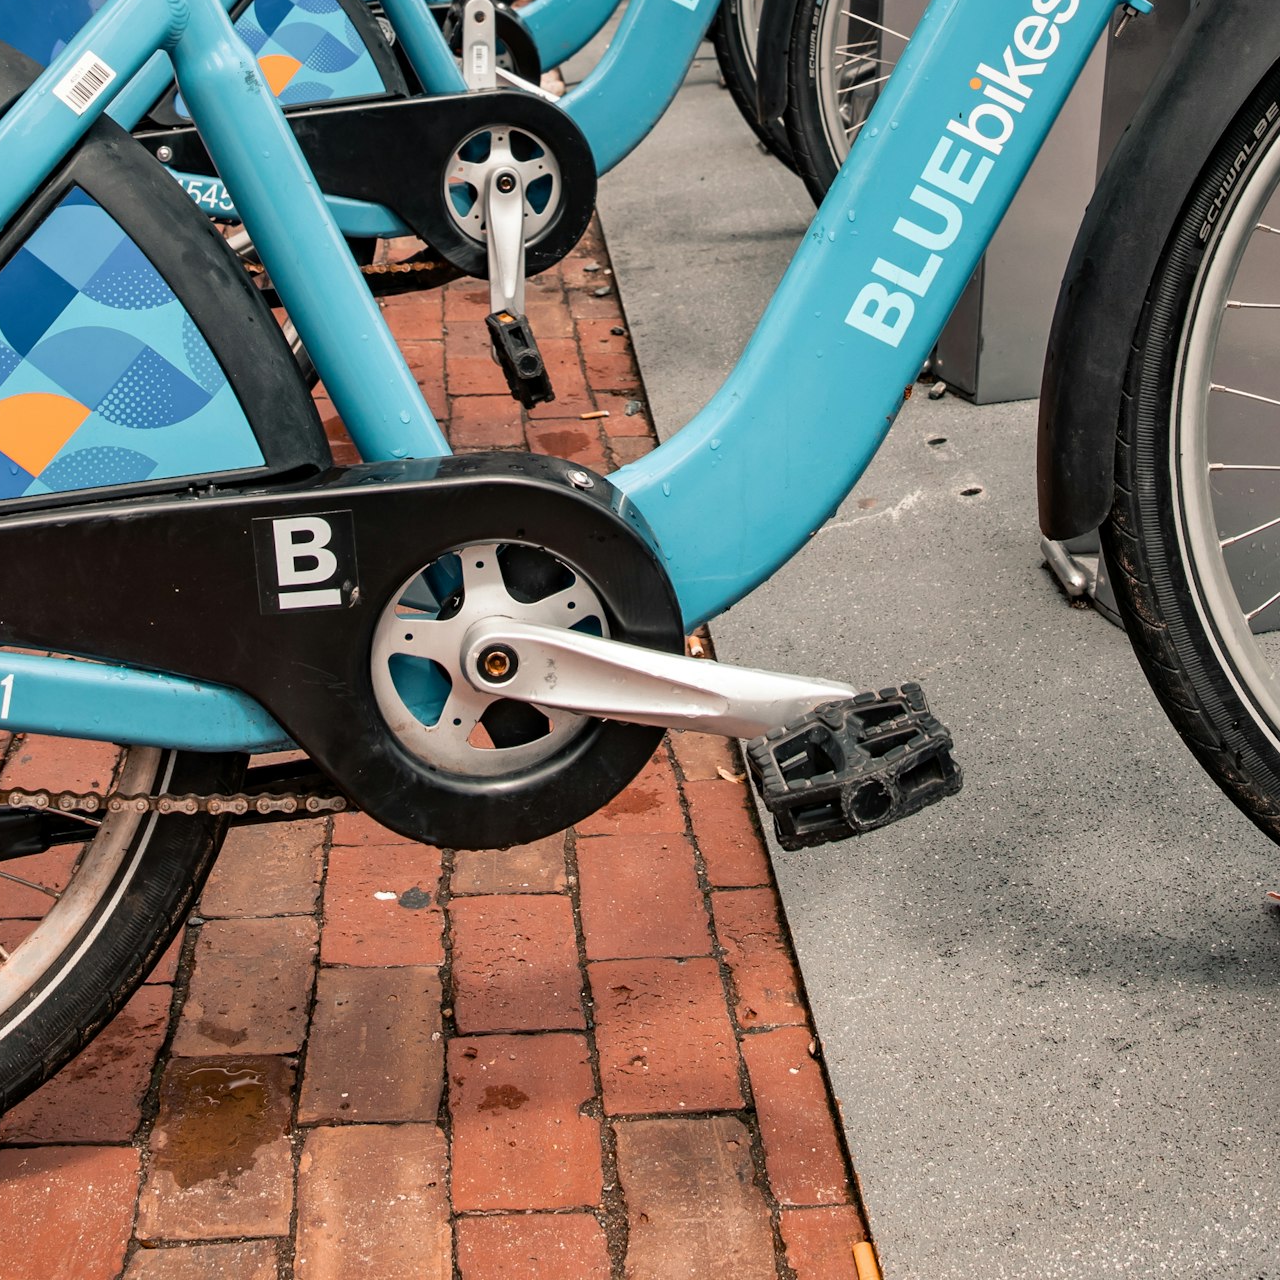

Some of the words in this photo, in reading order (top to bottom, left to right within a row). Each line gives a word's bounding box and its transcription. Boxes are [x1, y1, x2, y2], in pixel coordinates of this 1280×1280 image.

[177, 179, 235, 210] 545
[1198, 101, 1280, 242] SCHWALBE
[272, 516, 338, 586] B
